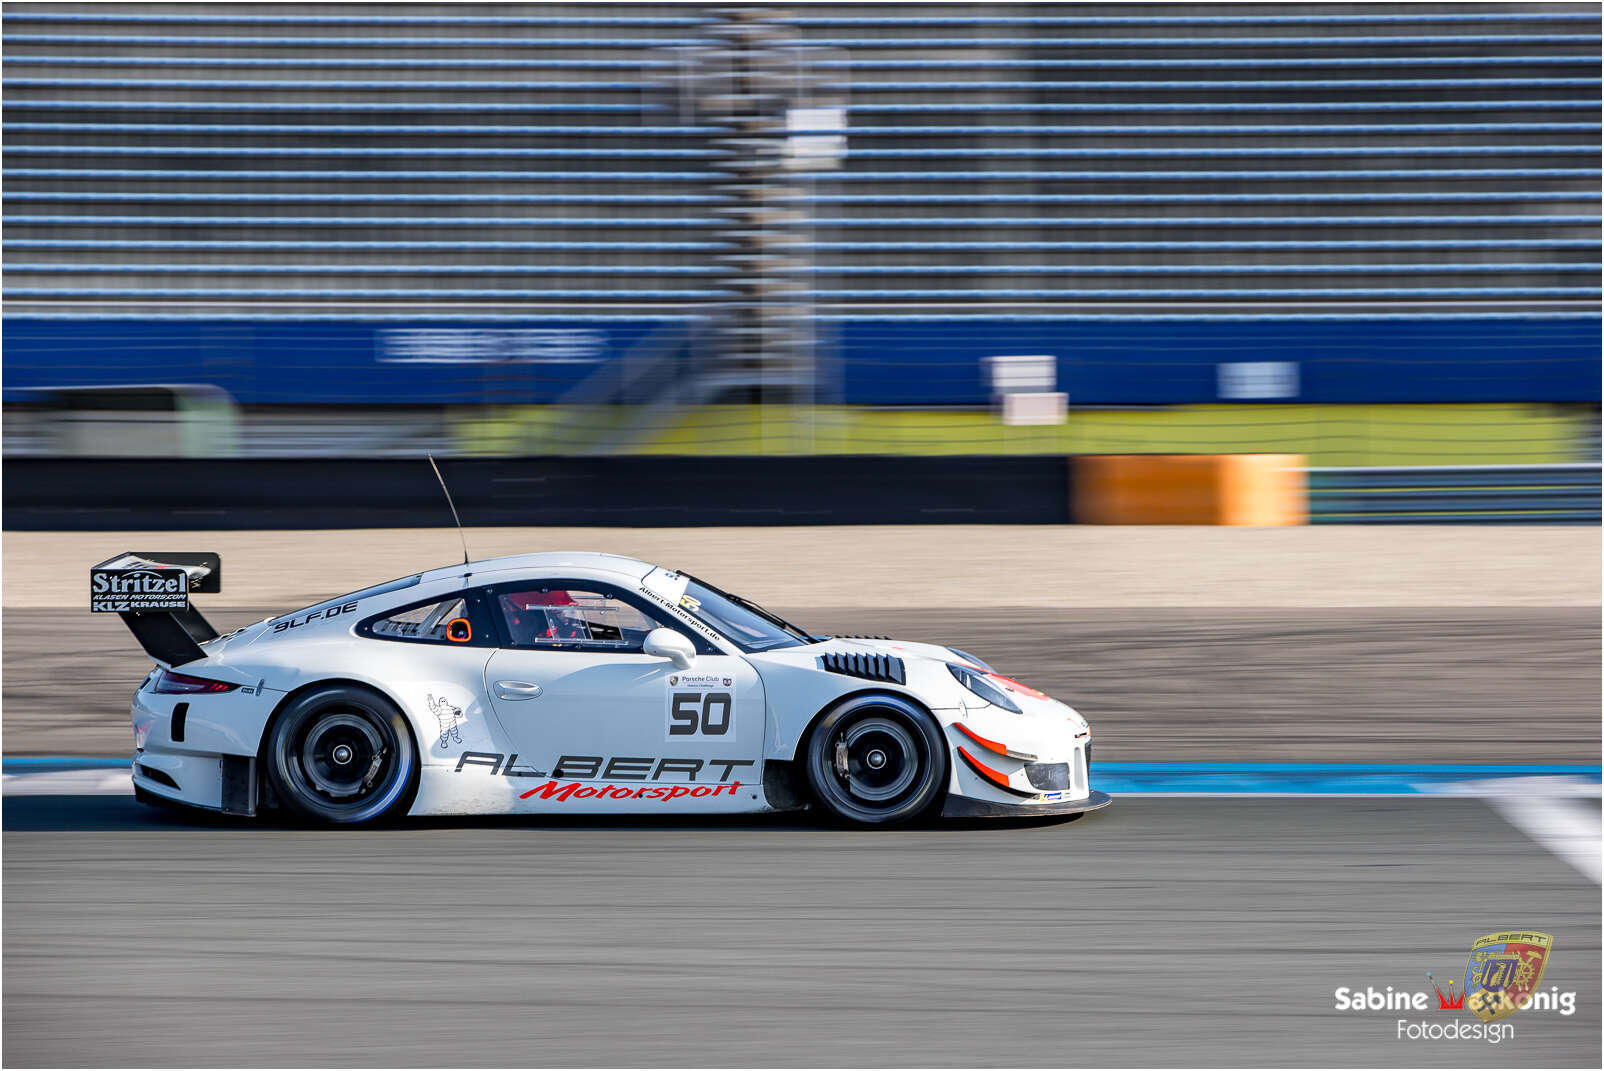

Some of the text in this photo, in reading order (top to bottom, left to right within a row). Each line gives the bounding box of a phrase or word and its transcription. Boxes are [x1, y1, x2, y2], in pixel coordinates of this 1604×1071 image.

[92, 572, 186, 593] Stritzel
[93, 601, 130, 612] KLZ
[273, 601, 359, 634] 9LF.DE
[669, 692, 732, 736] 50
[454, 751, 755, 782] ALBERT
[519, 780, 745, 803] Motorsport
